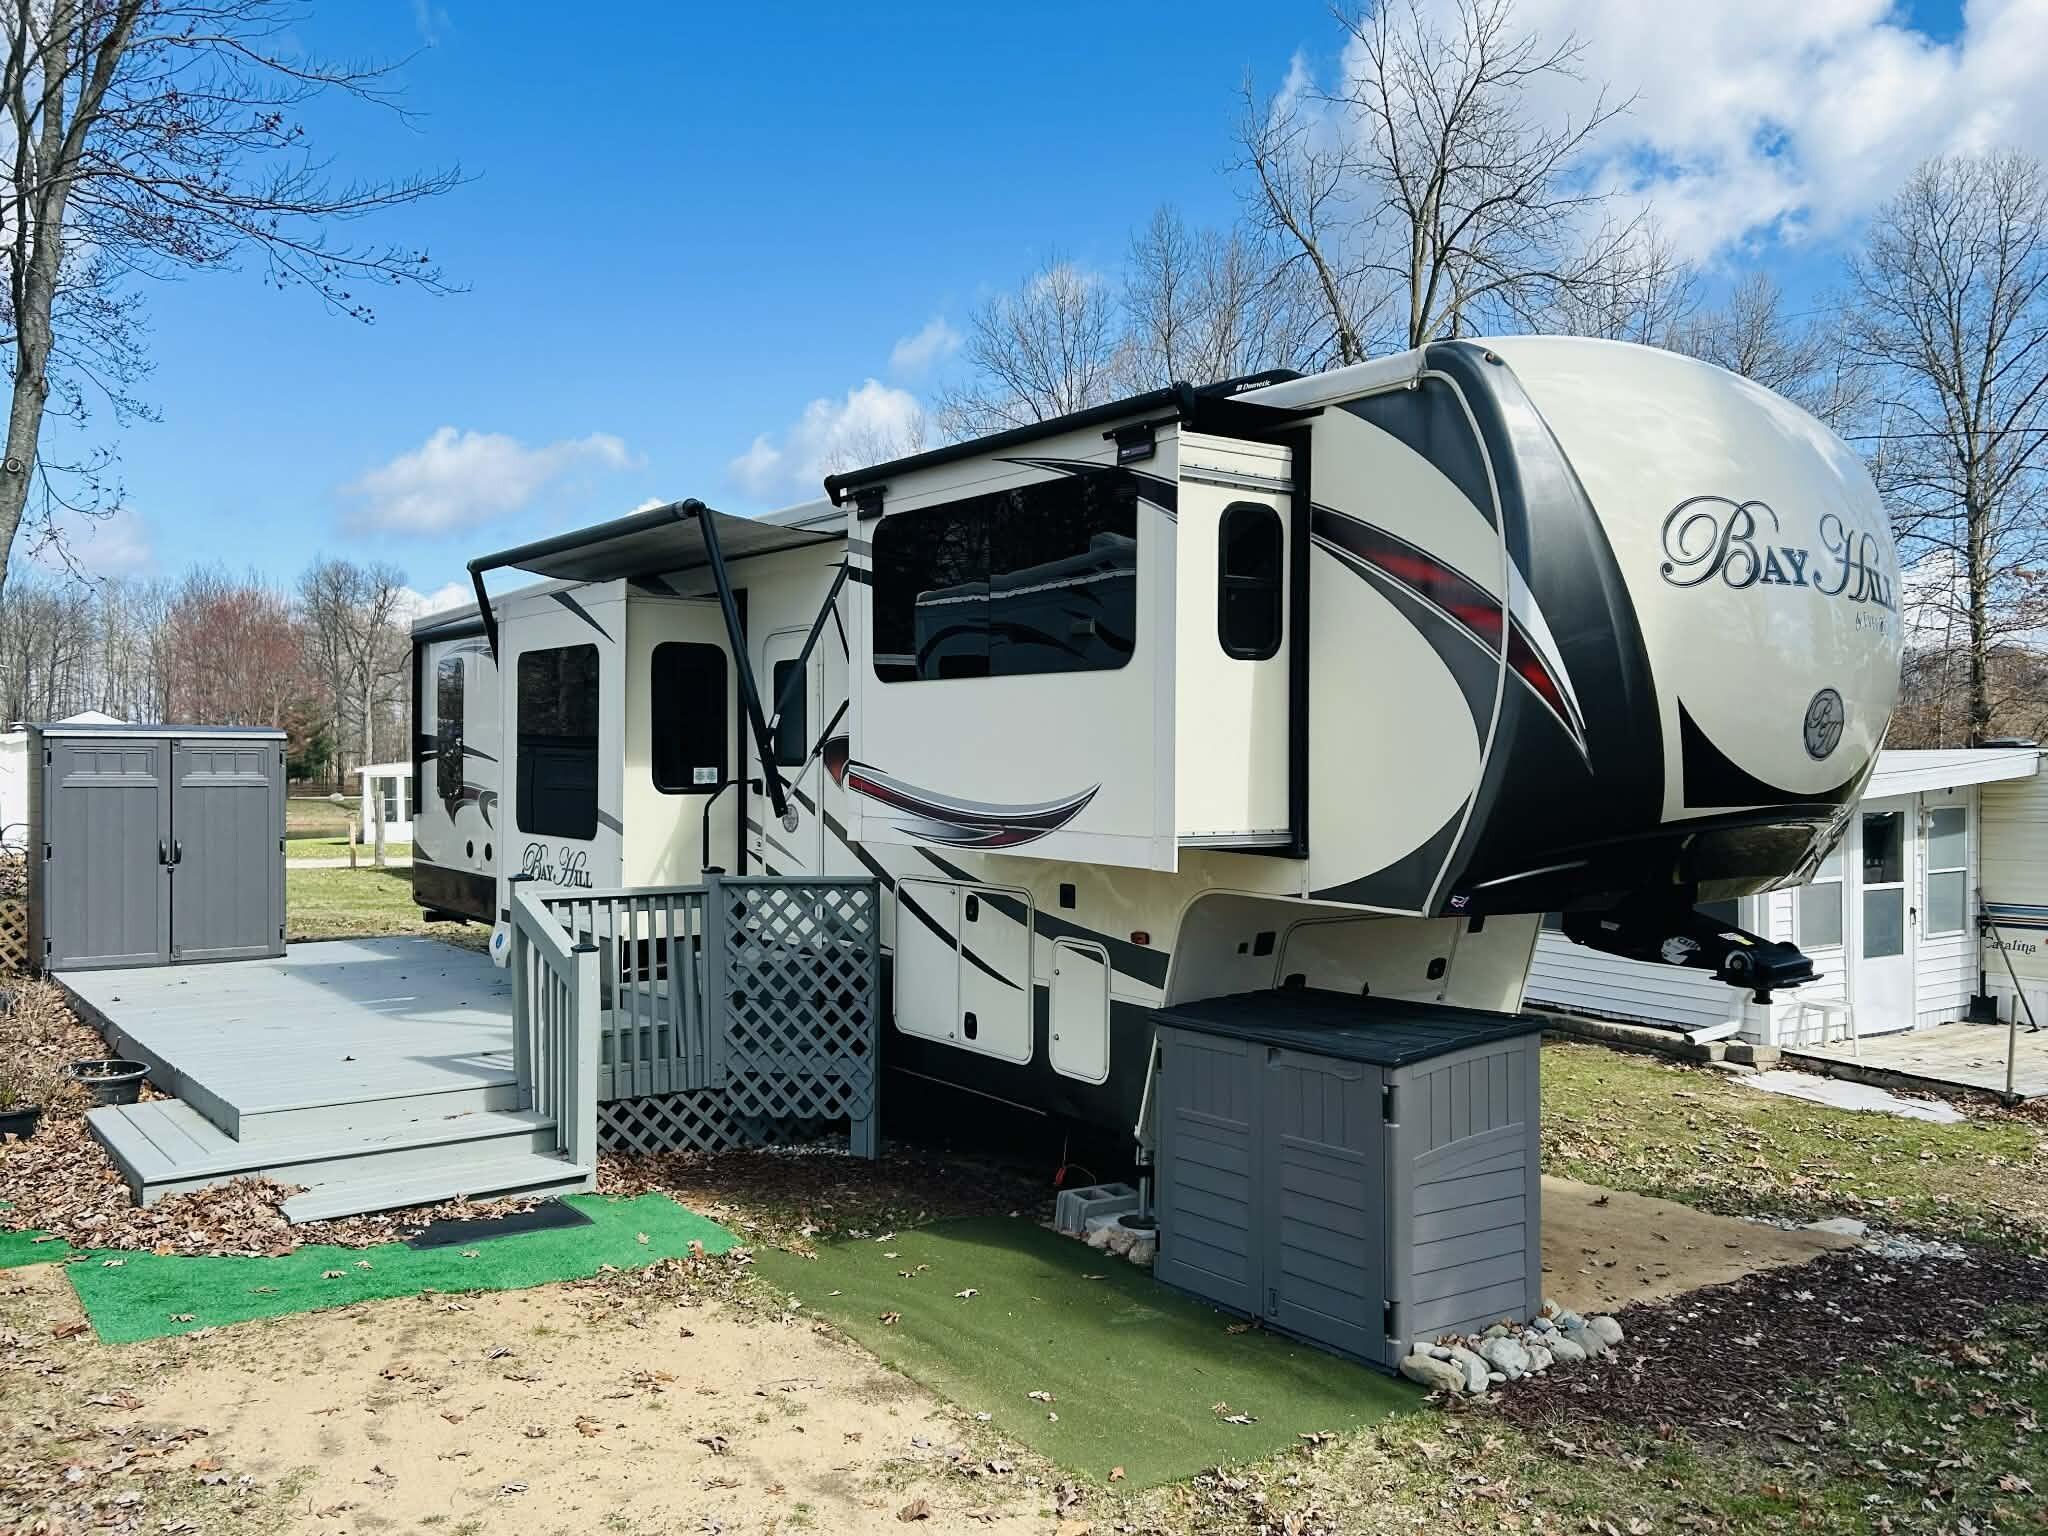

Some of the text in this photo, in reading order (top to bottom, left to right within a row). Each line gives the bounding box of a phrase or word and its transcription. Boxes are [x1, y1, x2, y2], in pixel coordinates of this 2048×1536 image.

[1660, 495, 1809, 590] BAY
[521, 842, 593, 889] BAY HILL
